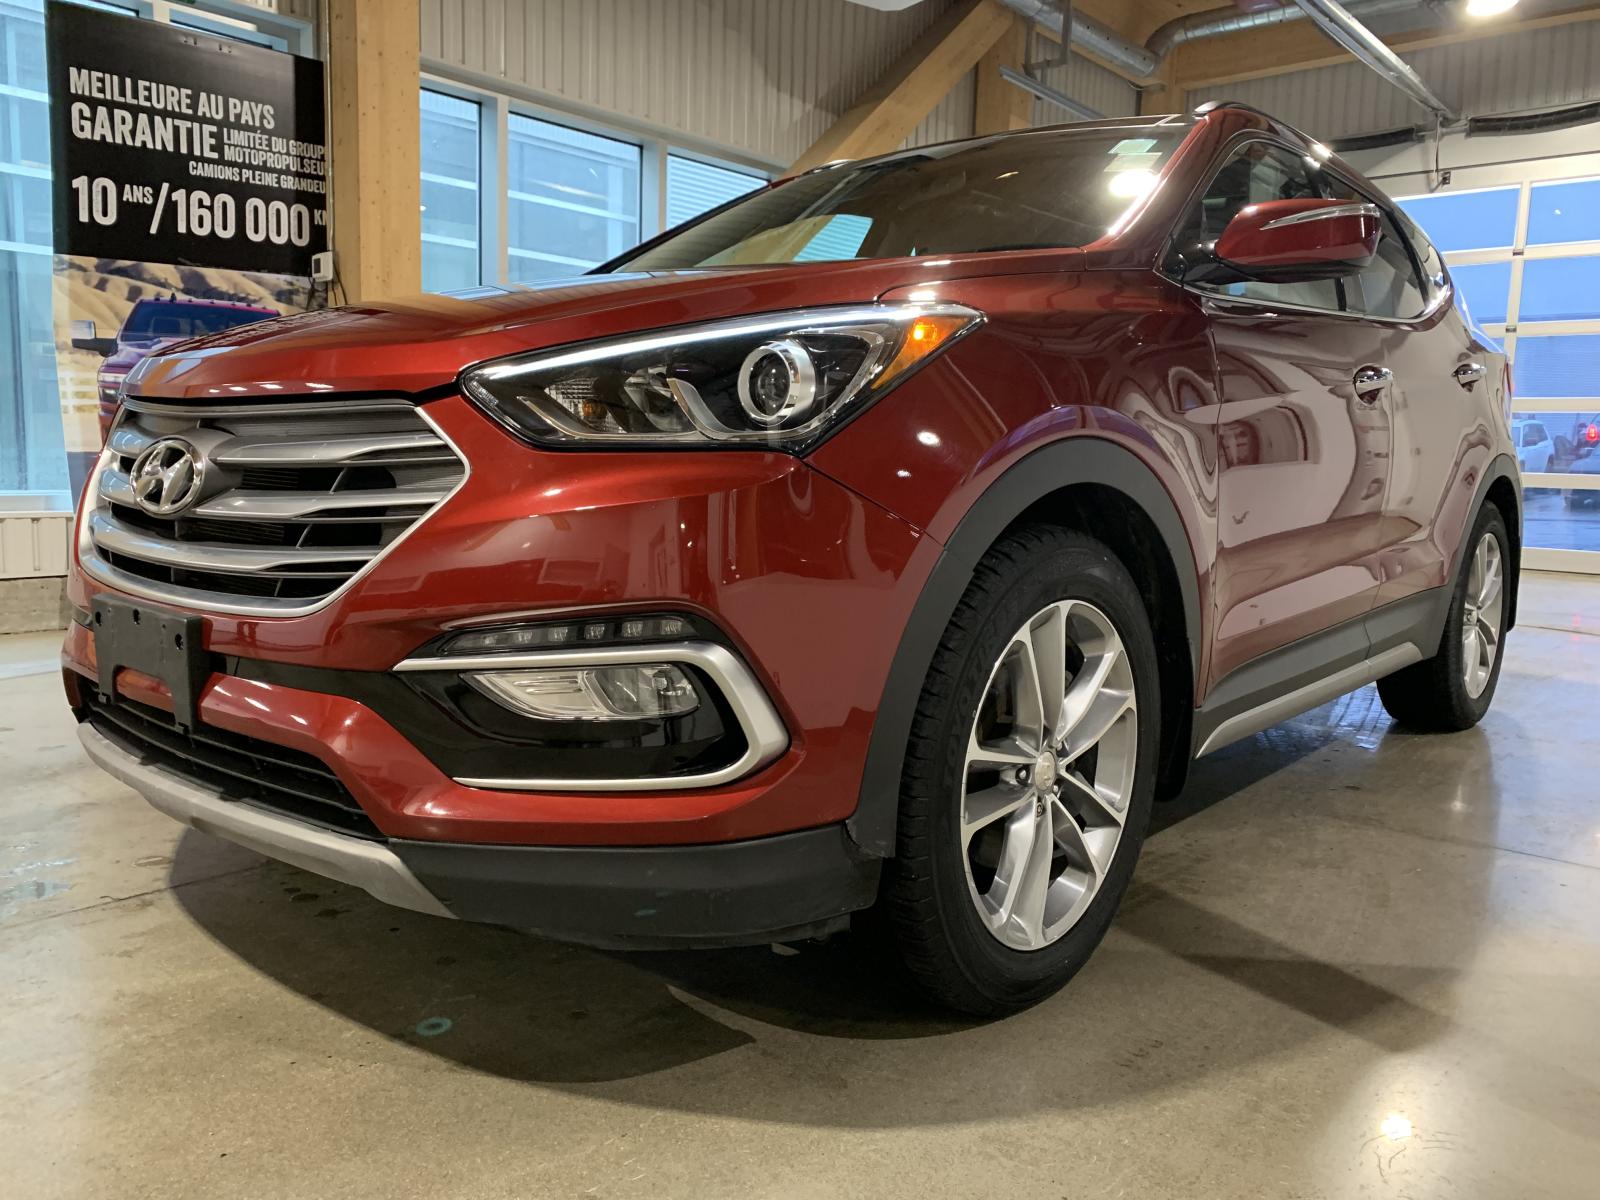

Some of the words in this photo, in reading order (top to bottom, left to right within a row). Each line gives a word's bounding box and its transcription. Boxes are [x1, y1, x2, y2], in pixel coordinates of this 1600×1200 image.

[69, 67, 193, 114] MEILLEURE
[197, 92, 223, 120] AU
[228, 98, 275, 130] PAYS
[71, 102, 219, 159] GARANTIE
[223, 128, 269, 151] LIMITÉE
[271, 136, 287, 154] DU
[289, 139, 325, 159] GROUP
[189, 160, 240, 182] CAMIONS
[241, 168, 279, 188] PLEINE
[280, 174, 326, 194] GRANDEU
[224, 145, 325, 176] MOTOPROPULSEU
[71, 175, 118, 226] 10
[123, 184, 154, 205] ANS
[245, 197, 310, 247] 000
